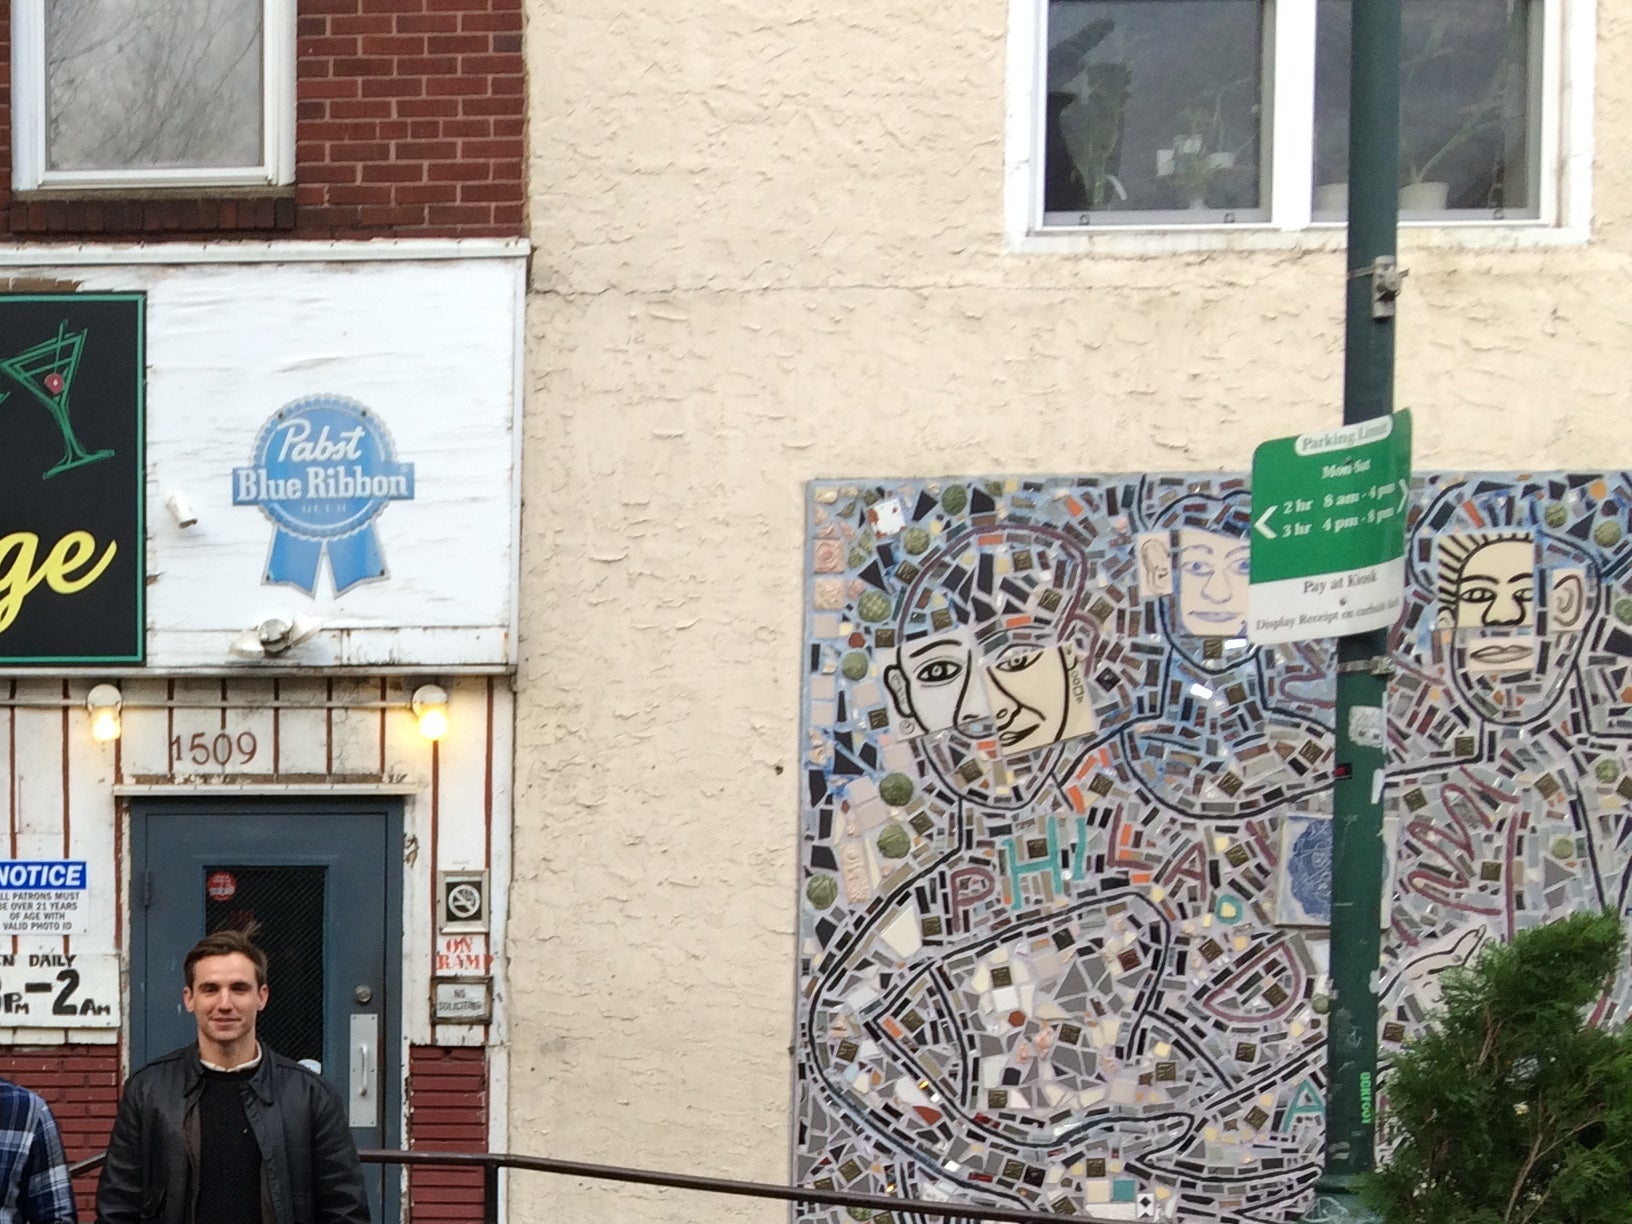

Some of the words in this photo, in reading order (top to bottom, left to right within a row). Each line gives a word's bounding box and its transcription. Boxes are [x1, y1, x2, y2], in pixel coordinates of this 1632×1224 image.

[278, 417, 366, 463] Pabst
[1302, 430, 1357, 453] Parking
[236, 467, 302, 502] Blue
[305, 464, 409, 500] Ribbon
[1283, 501, 1294, 515] 2
[1295, 498, 1314, 514] hr
[1334, 492, 1360, 506] am
[1368, 487, 1379, 501] 4
[1377, 483, 1396, 500] pm
[1282, 524, 1292, 538] 3
[1294, 520, 1312, 536] hr
[1321, 519, 1331, 533] 4
[1334, 517, 1359, 533] pm
[1376, 507, 1395, 526] pm
[1303, 579, 1327, 596] Pay
[1329, 577, 1345, 591] at
[1347, 570, 1378, 589] Kiosk
[1255, 616, 1296, 631] Display
[1298, 610, 1339, 624] Receipt
[170, 731, 259, 767] 1509
[10, 902, 34, 911] OVER
[36, 902, 48, 911] 21
[49, 902, 78, 911] YEARS
[12, 892, 52, 901] PATRONS
[54, 892, 80, 901] MUST
[2, 922, 29, 931] VALID
[30, 922, 60, 931] PHOTO
[62, 922, 72, 931] ID
[9, 912, 22, 921] OF
[23, 912, 41, 921] AGE
[43, 912, 66, 921] WITH
[445, 937, 474, 954] ON
[28, 954, 78, 968] DAILY
[436, 953, 495, 970] RAMP
